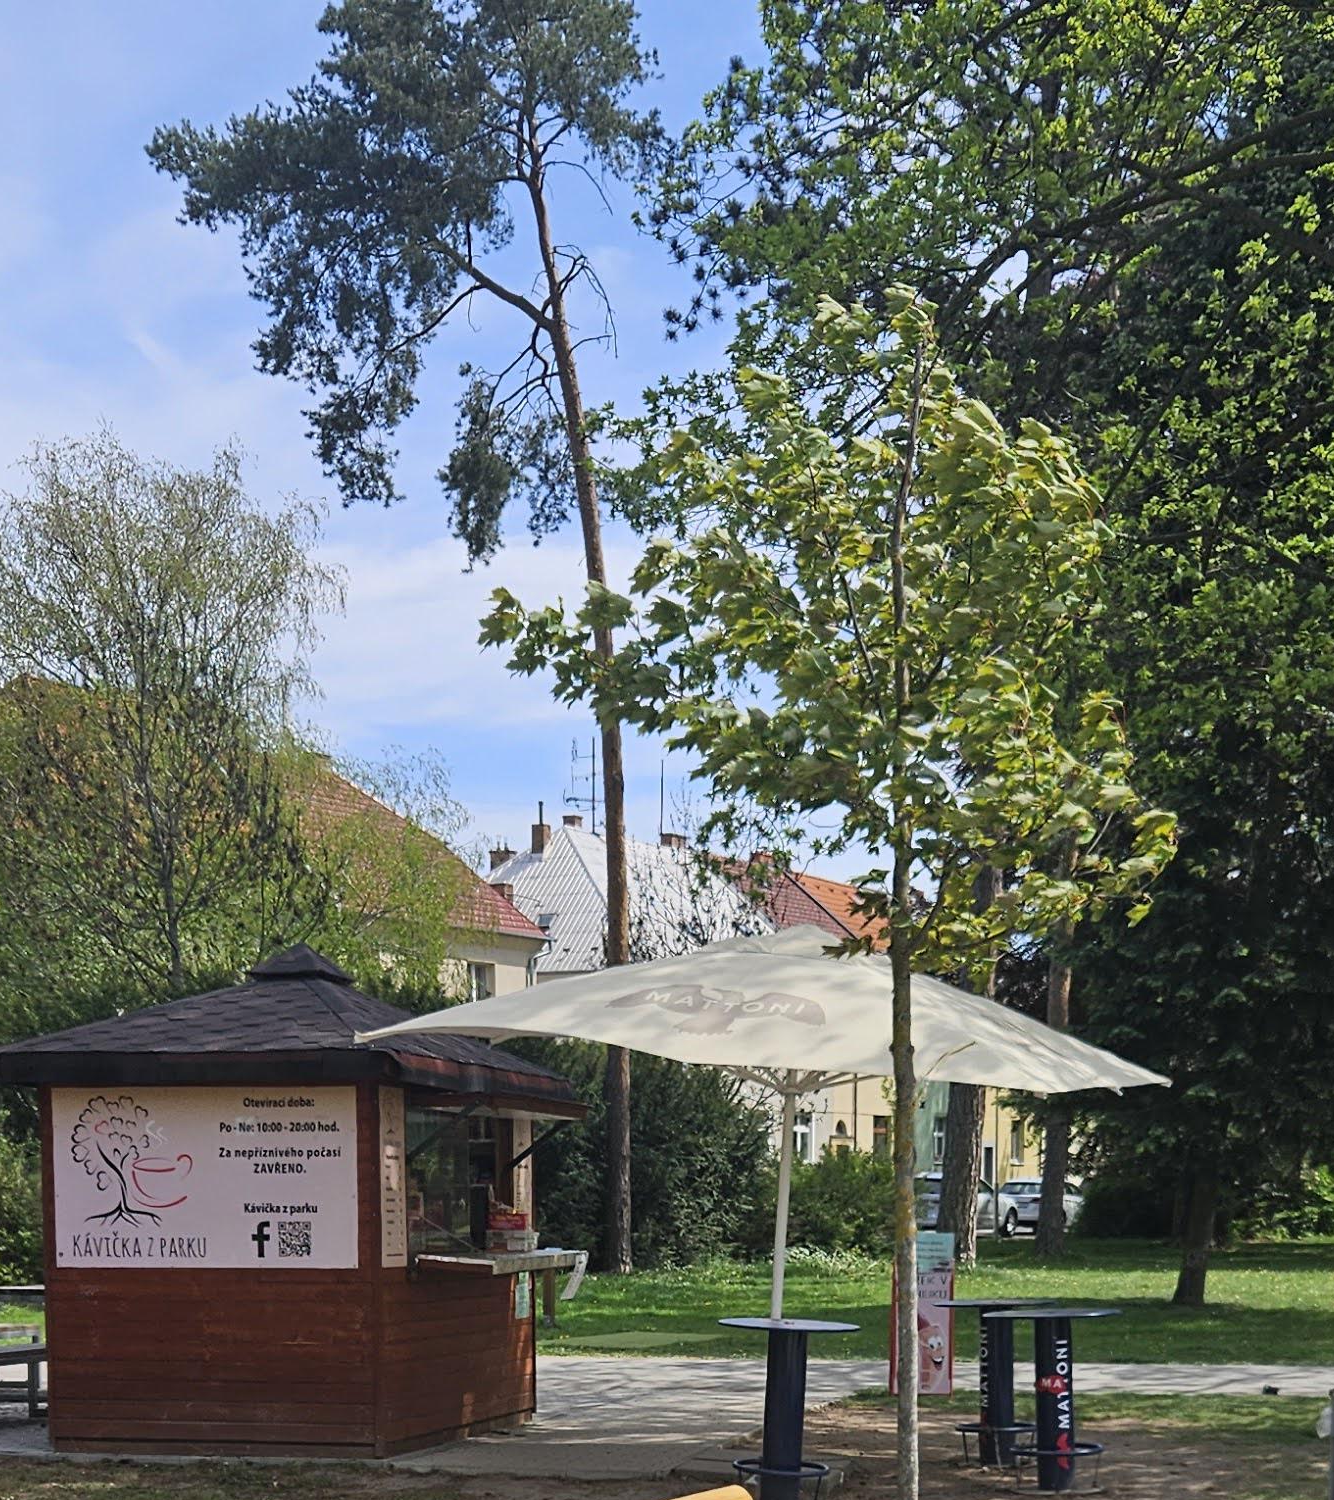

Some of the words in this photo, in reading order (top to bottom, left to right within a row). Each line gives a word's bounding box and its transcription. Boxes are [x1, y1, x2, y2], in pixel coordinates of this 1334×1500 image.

[645, 990, 806, 1014] MATTONI
[287, 1097, 315, 1107] doba:
[219, 1122, 232, 1133] Po
[238, 1122, 255, 1133] Ne:
[256, 1122, 282, 1133] 10:00
[289, 1122, 316, 1133] 20:00
[318, 1121, 340, 1132] hod.
[219, 1147, 231, 1158] Za
[234, 1146, 304, 1161] nepříznivého
[306, 1146, 341, 1160] počasí
[253, 1161, 307, 1174] ZAVŘENO.
[244, 1202, 280, 1213] Kávička
[289, 1202, 318, 1216] parku
[73, 1231, 142, 1258] KÁVIČKA
[160, 1237, 207, 1258] PARKU
[979, 1326, 989, 1408] MATTONI
